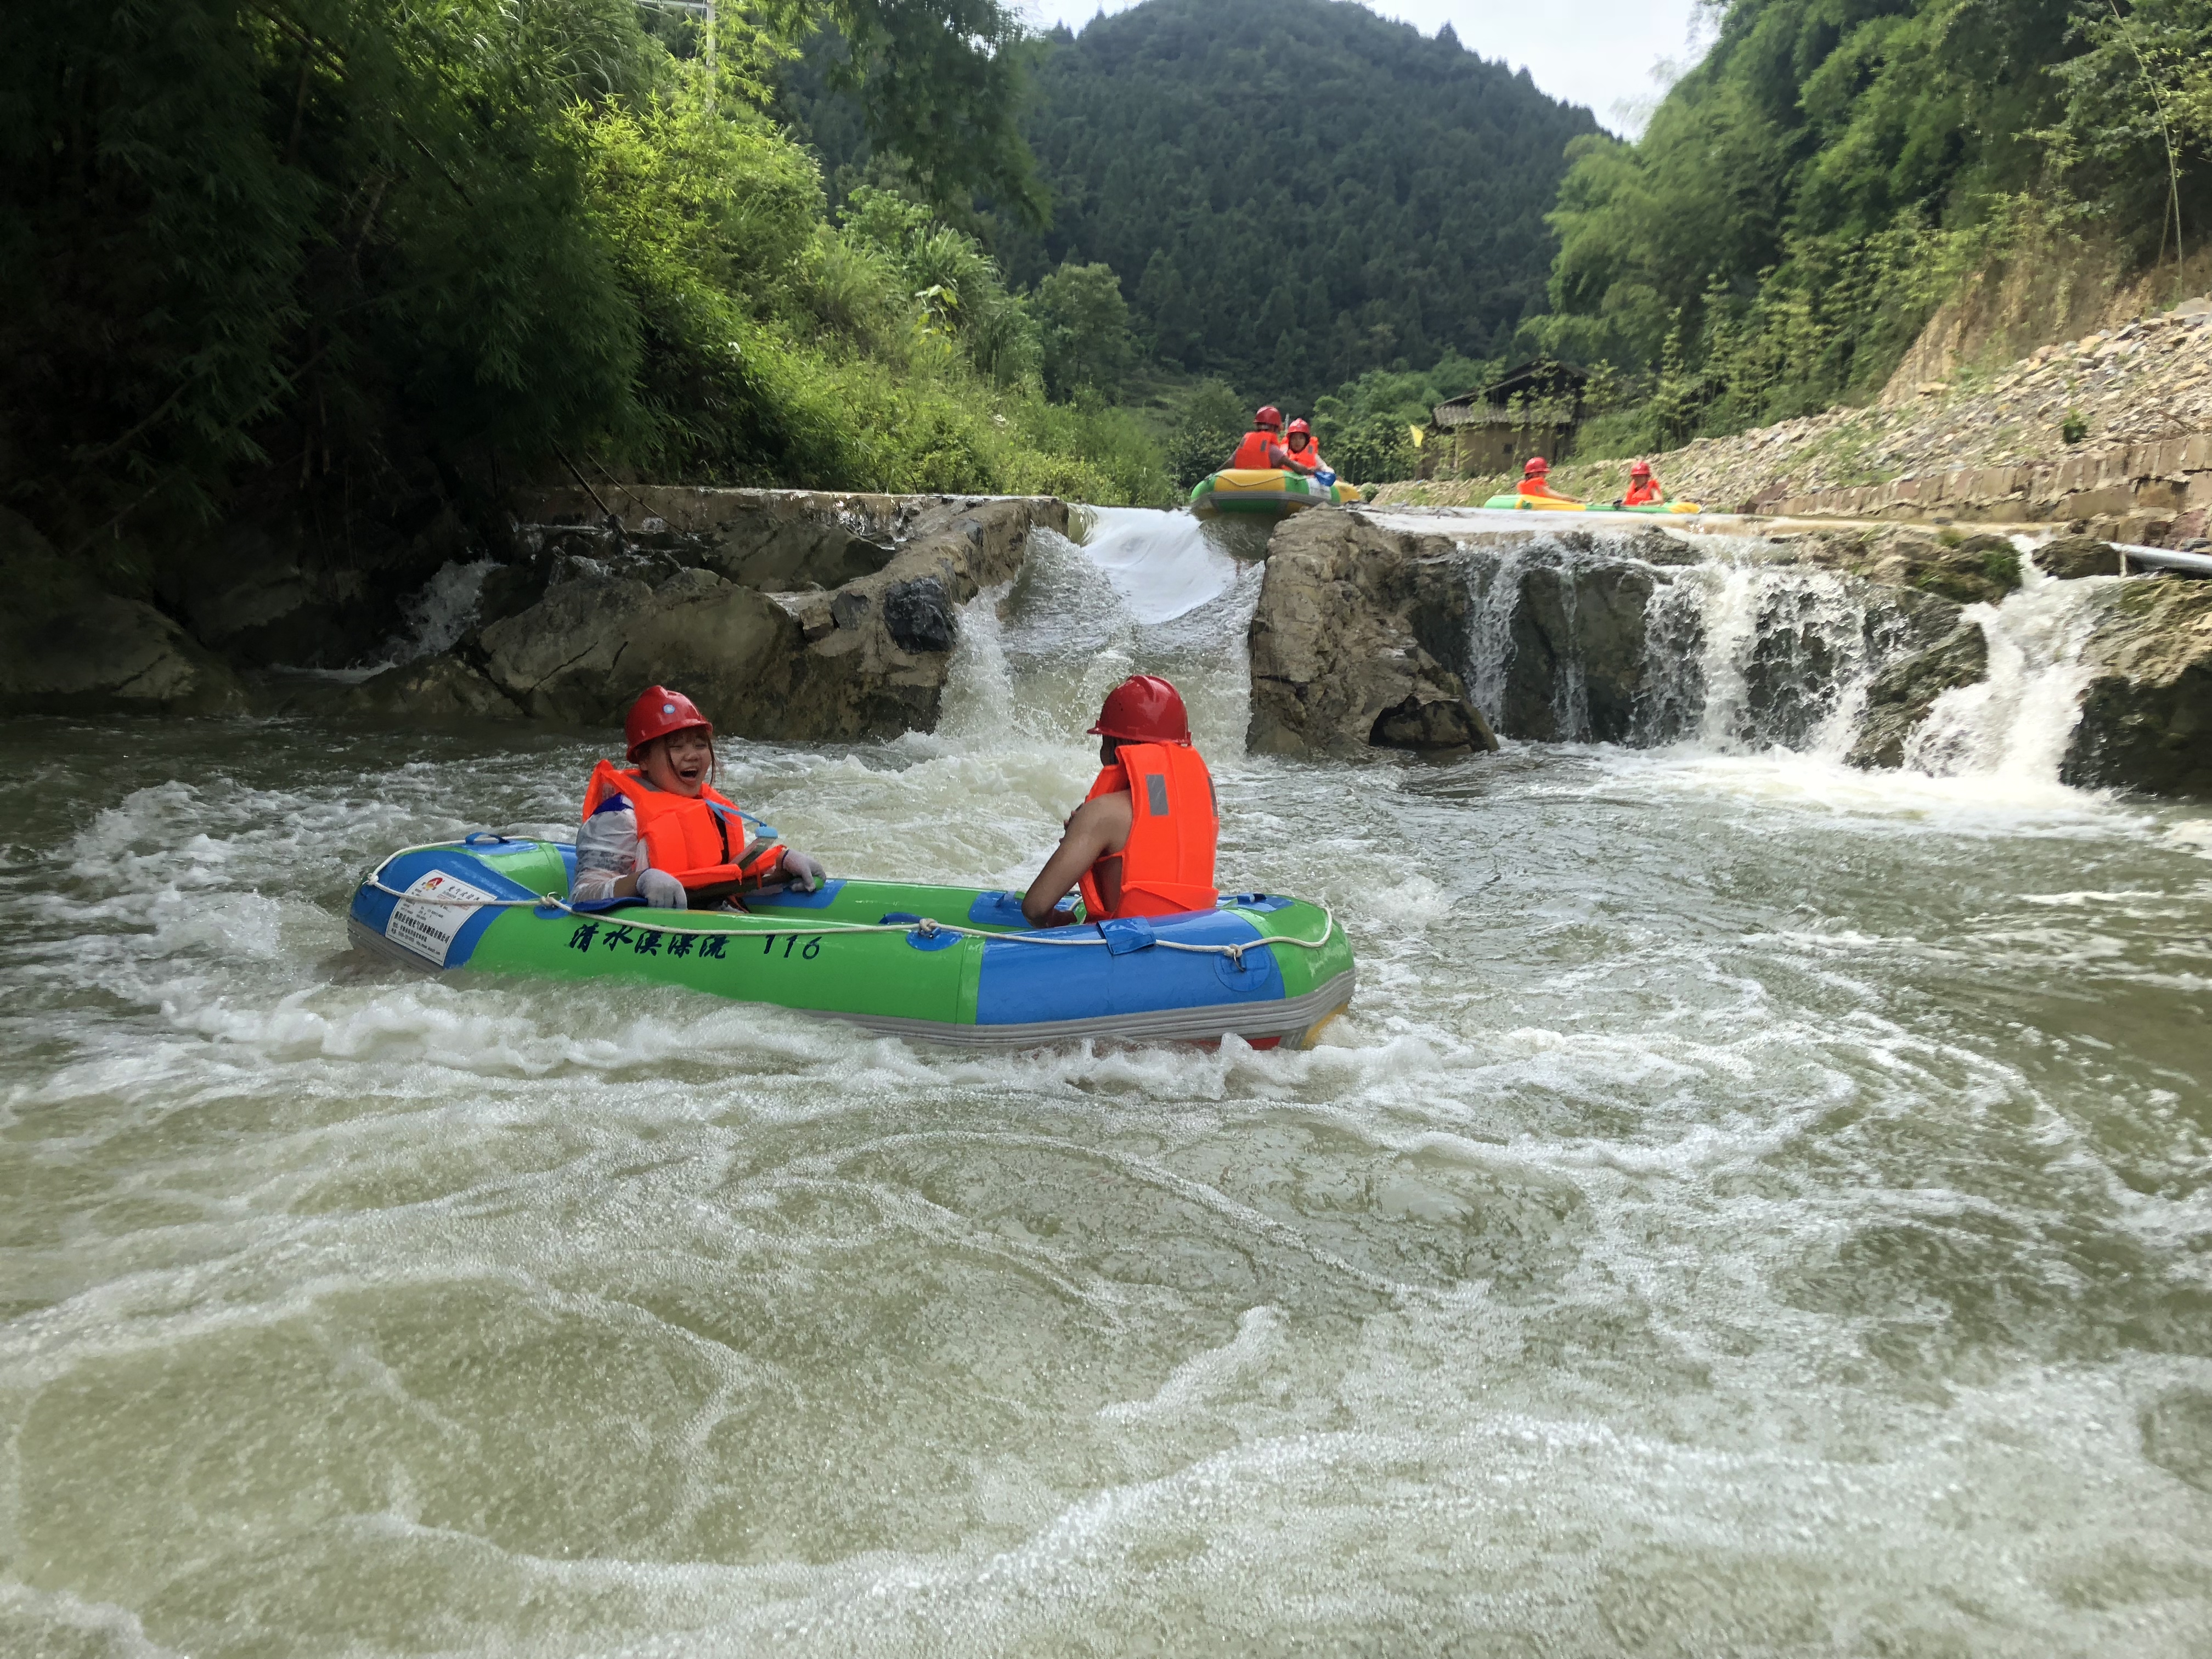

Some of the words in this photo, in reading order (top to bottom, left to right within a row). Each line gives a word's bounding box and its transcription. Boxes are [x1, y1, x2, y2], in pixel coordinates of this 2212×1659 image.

[569, 922, 729, 959] 清水溪漂流
[764, 934, 822, 960] 116
